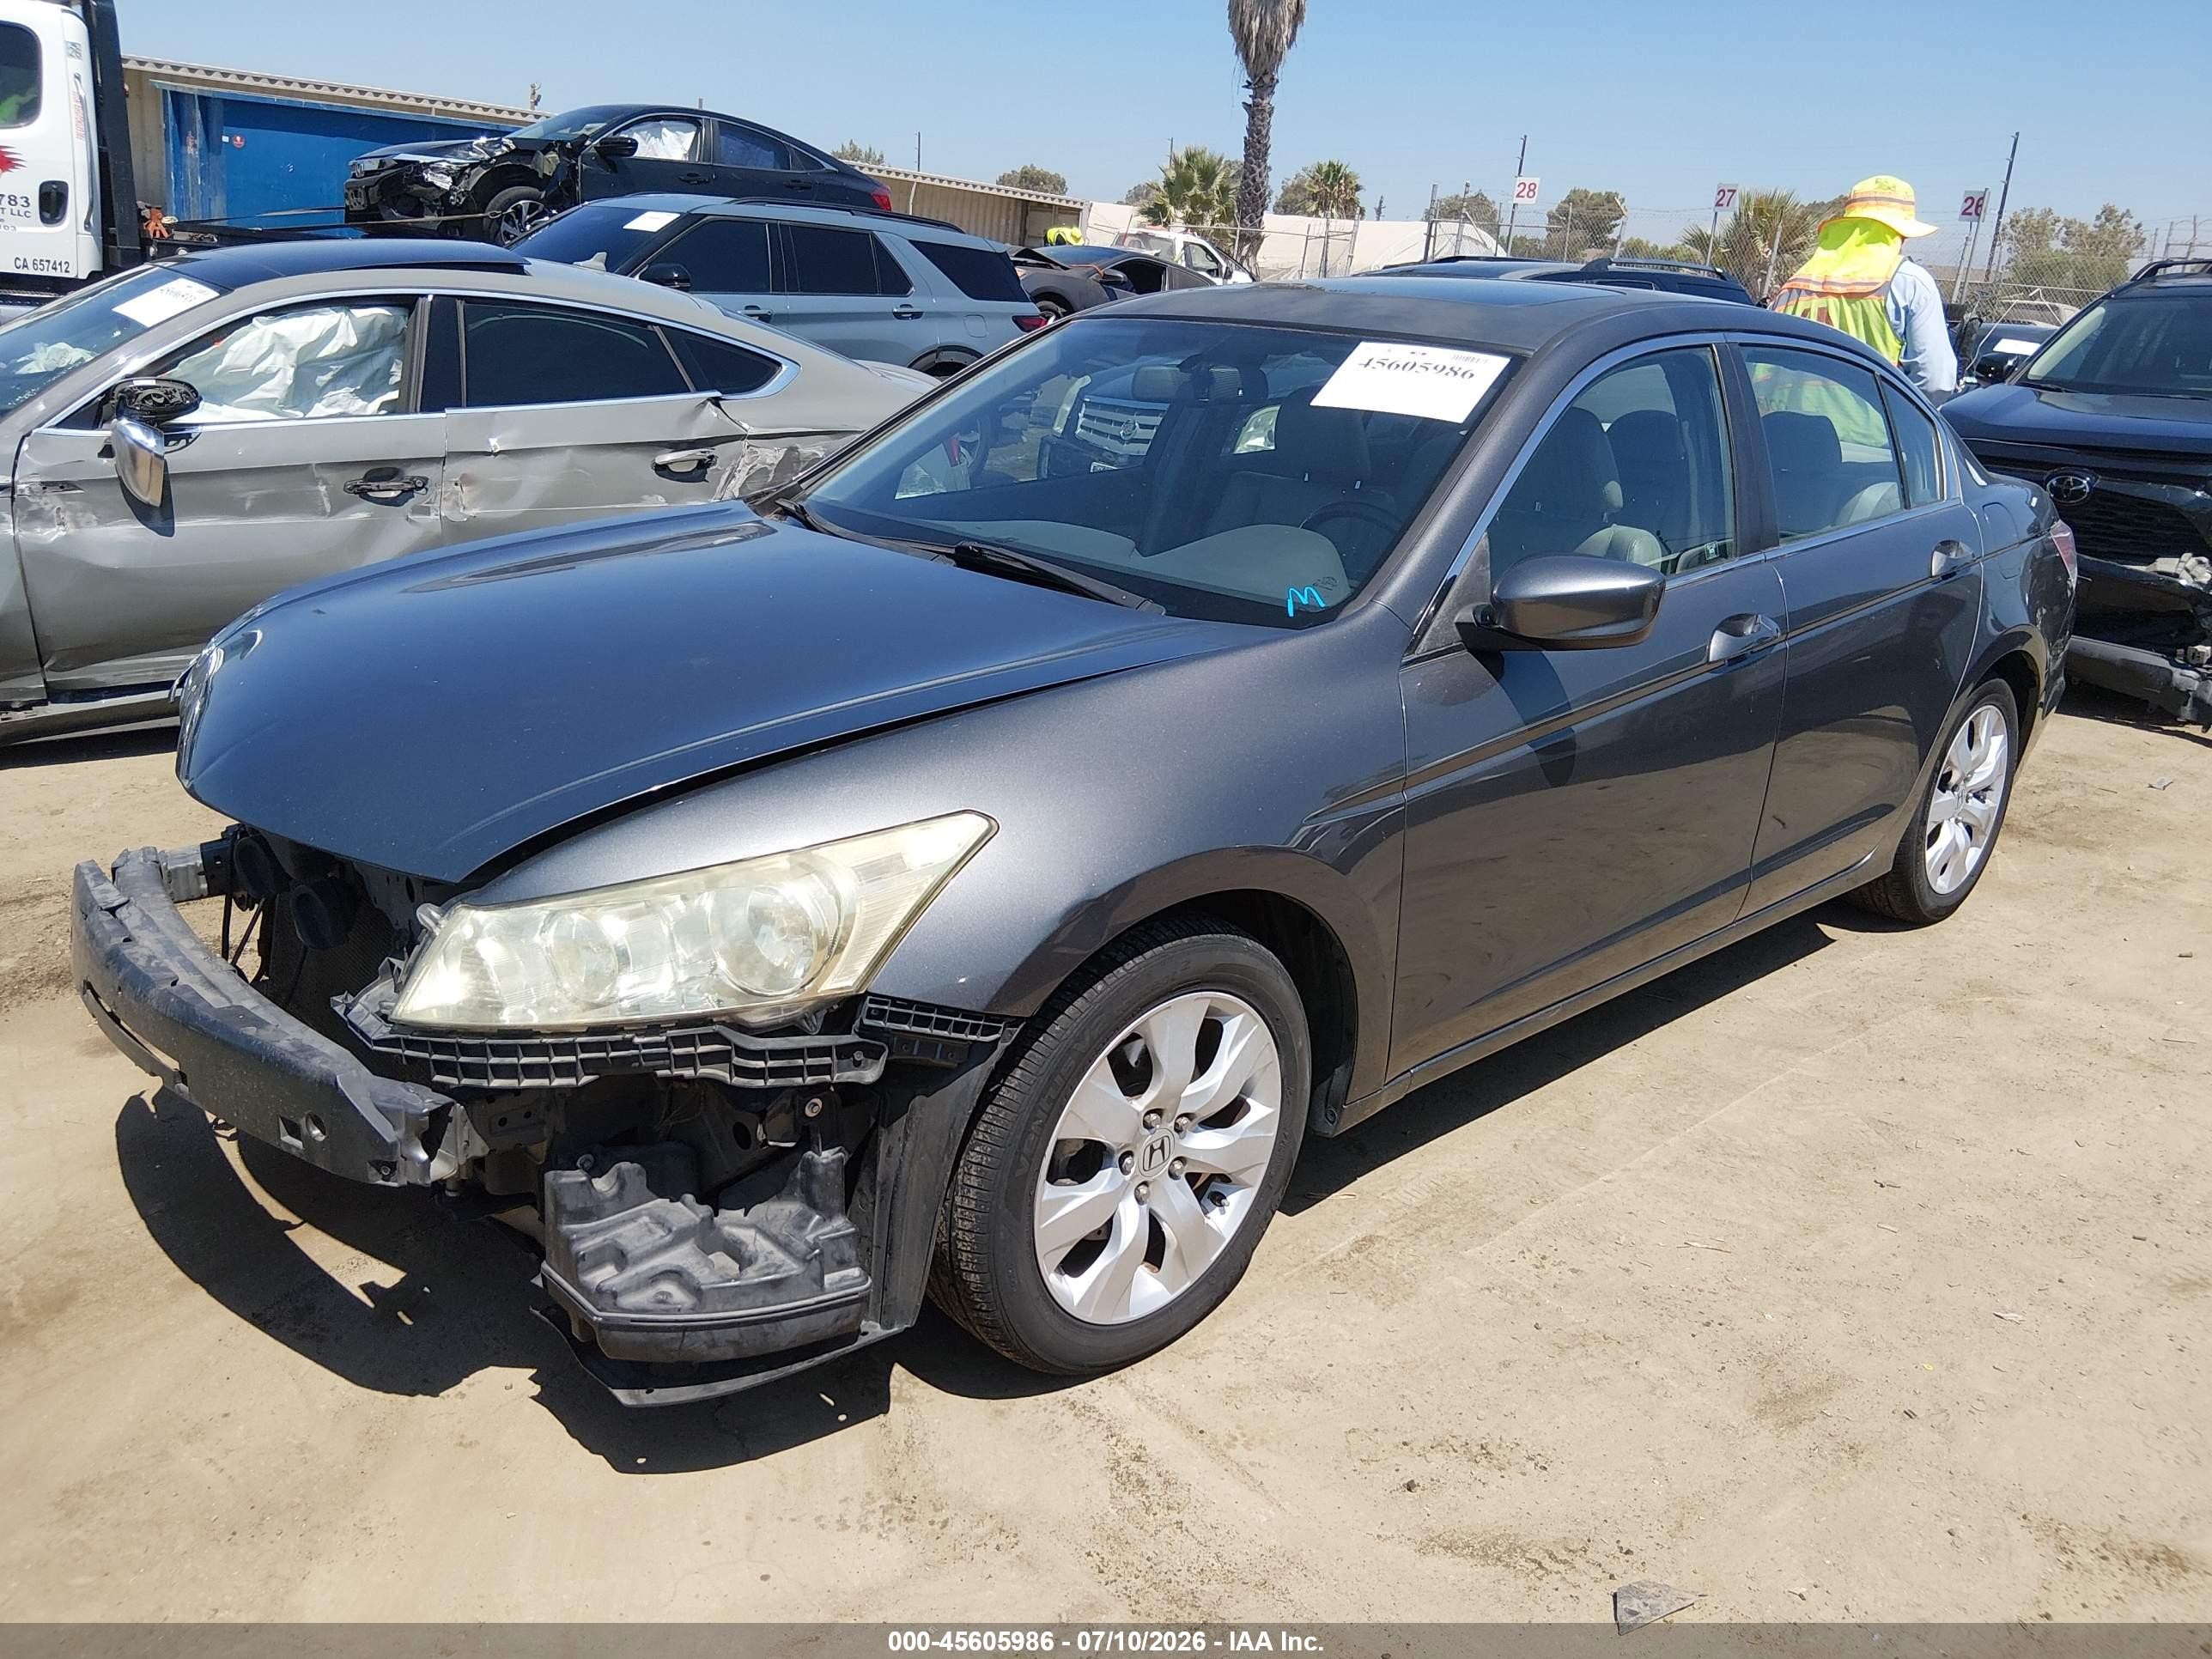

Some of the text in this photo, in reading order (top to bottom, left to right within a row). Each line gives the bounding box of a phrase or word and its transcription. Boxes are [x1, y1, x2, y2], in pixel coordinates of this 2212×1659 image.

[1516, 181, 1537, 199] 28
[1715, 188, 1737, 207] 27
[9, 208, 32, 218] LLC
[1961, 196, 1984, 216] 26
[14, 257, 70, 273] CA 657412
[1358, 356, 1475, 380] 45605986
